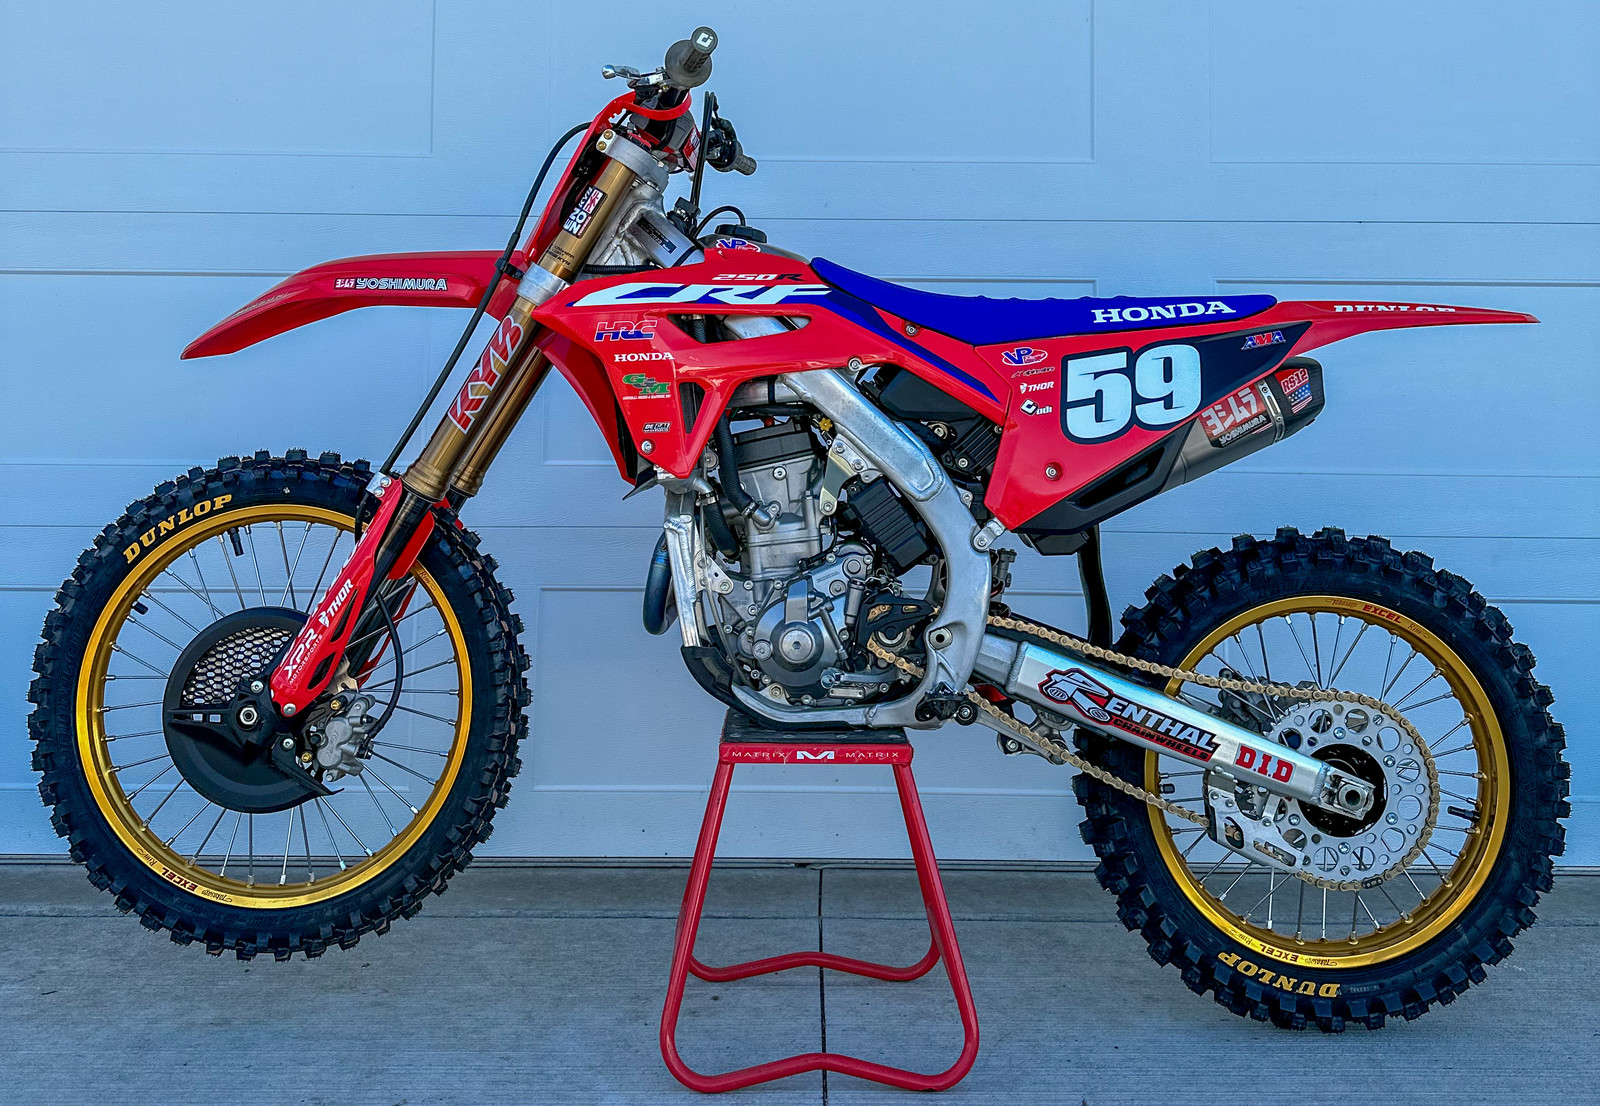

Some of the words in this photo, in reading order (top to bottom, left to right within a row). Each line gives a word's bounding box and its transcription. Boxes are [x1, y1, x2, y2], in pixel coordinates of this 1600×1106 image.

[355, 278, 448, 291] YOSHIMURA
[712, 272, 808, 281] 250R
[572, 282, 833, 307] CRF
[1091, 301, 1237, 324] HONDA
[594, 320, 658, 341] HRC
[1241, 330, 1287, 351] AMA
[613, 352, 675, 362] HONDA
[1001, 346, 1034, 365] VP
[1028, 381, 1055, 392] THOR
[1065, 344, 1202, 440] 59
[1280, 368, 1309, 395] RS12
[1218, 414, 1267, 445] YOSHIMURA
[122, 493, 233, 565] DUNLOP
[325, 578, 354, 617] THOR
[1362, 604, 1402, 624] EXCEL
[283, 627, 318, 680] XPR
[289, 634, 323, 685] MOTORSPORTS
[1112, 718, 1210, 761] CHAINWHEELS
[1238, 744, 1295, 784] D.I.D
[161, 867, 198, 891] EXCEL
[1259, 943, 1299, 962] EXCEL
[1217, 951, 1341, 998] DUNLOP
